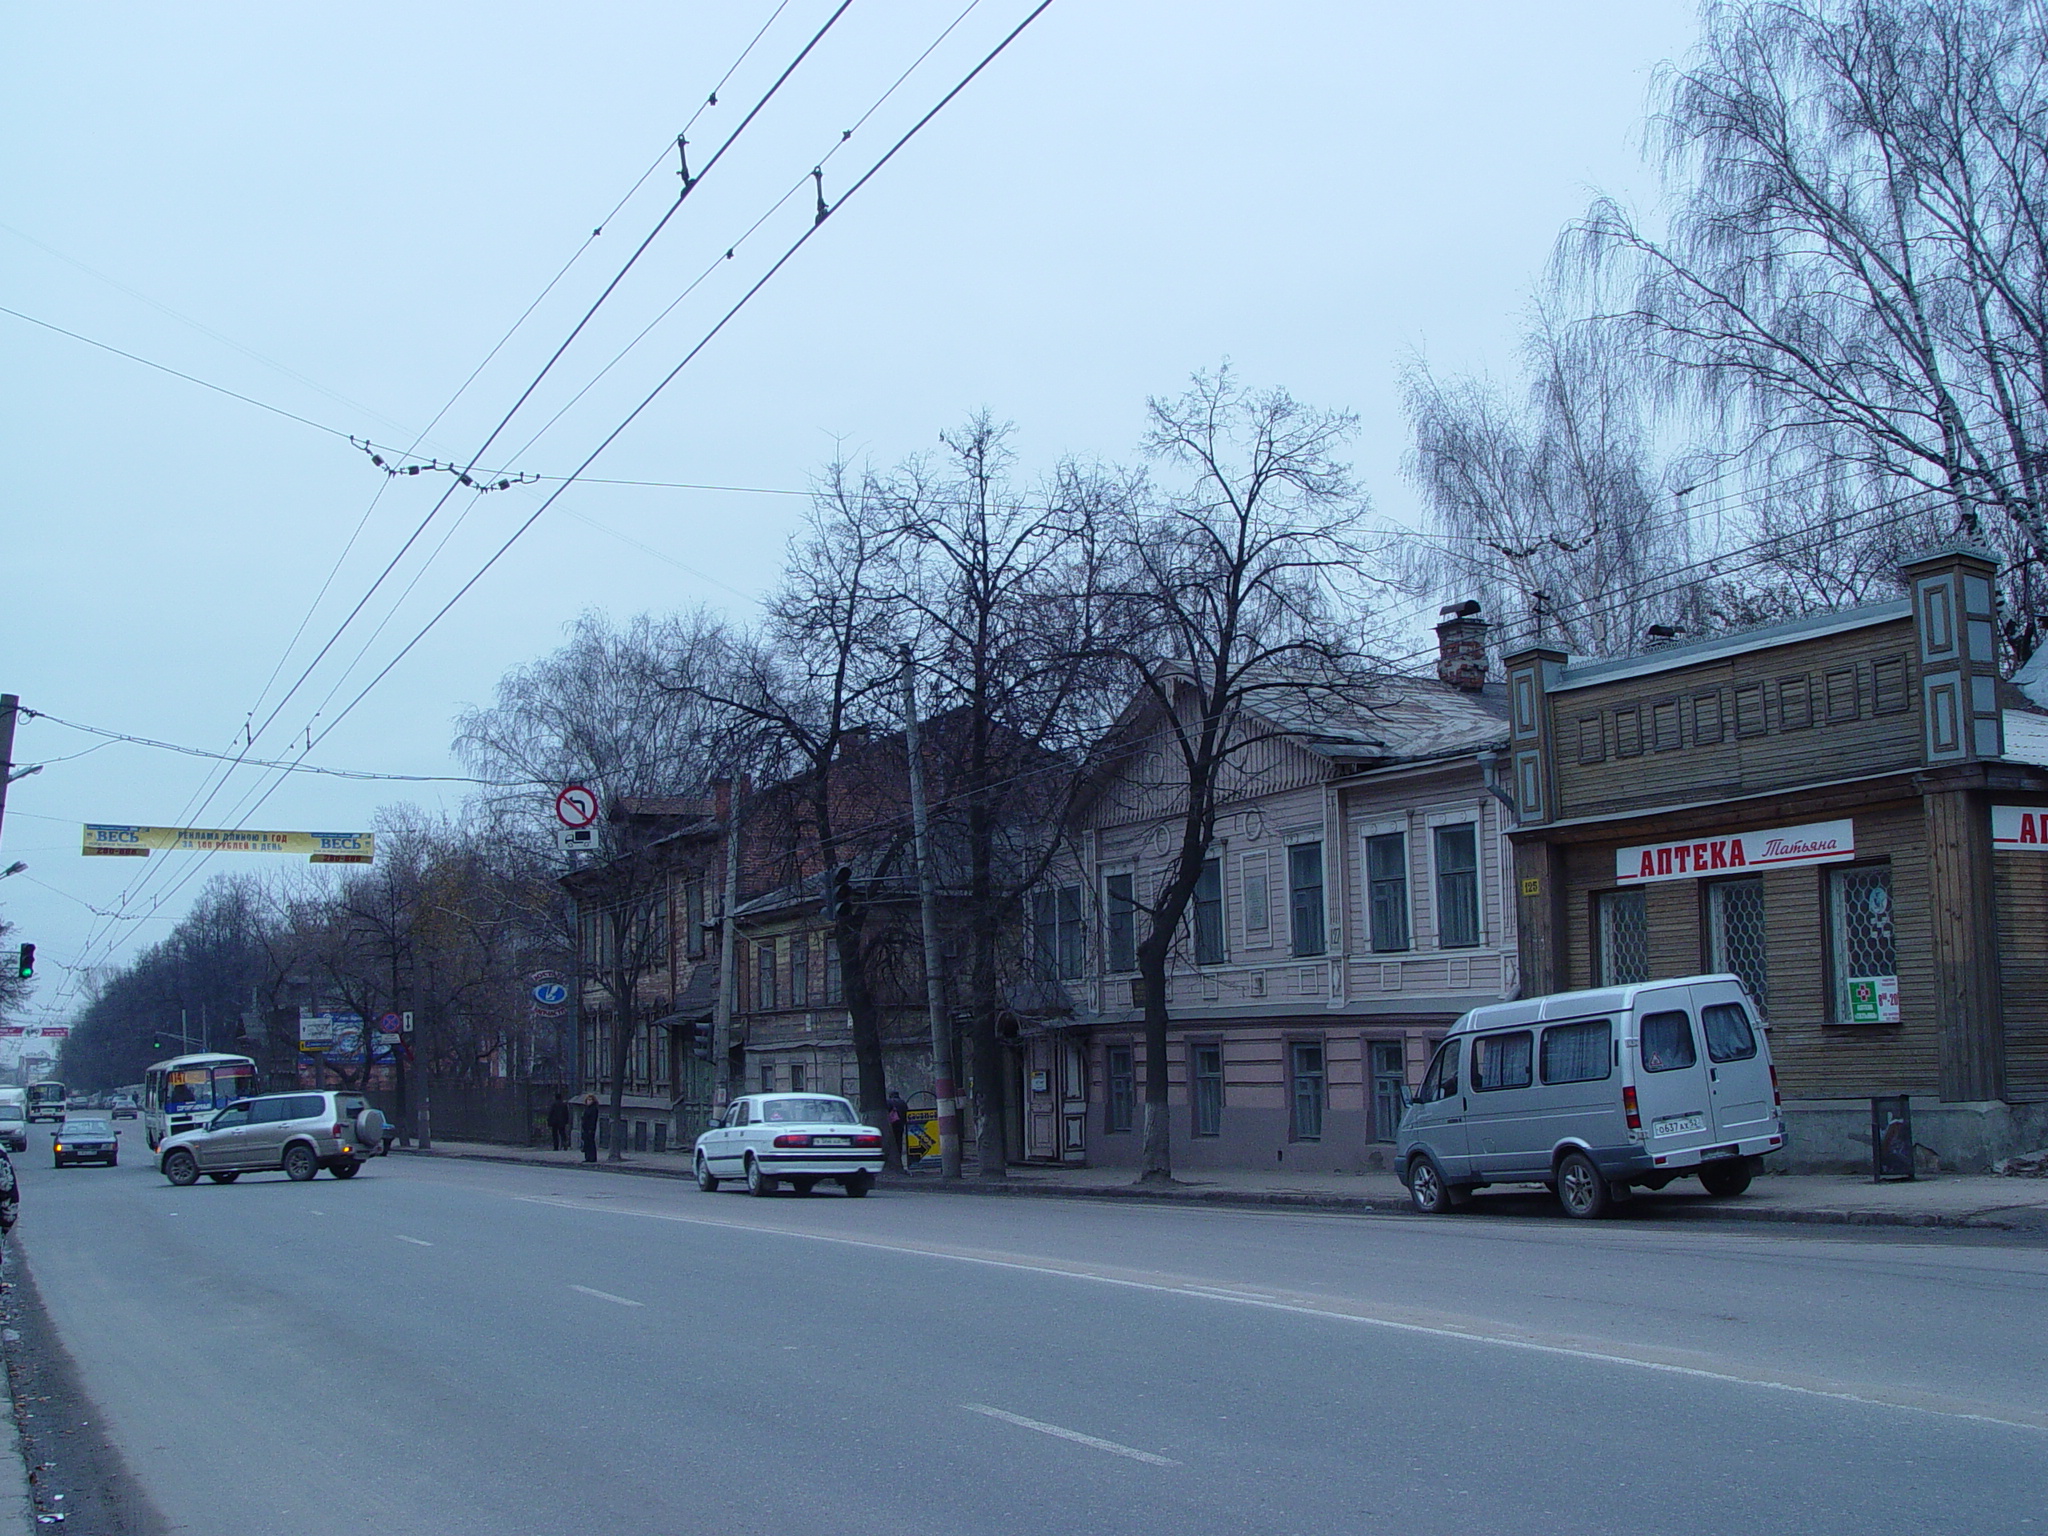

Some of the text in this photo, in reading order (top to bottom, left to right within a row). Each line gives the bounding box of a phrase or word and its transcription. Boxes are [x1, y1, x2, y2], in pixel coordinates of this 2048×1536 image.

[97, 831, 139, 843] ВЕСЬ
[262, 834, 268, 842] В
[271, 834, 288, 843] ГОД
[182, 840, 194, 848] ЗА
[215, 841, 249, 850] РУБЛЕЙ
[260, 843, 283, 851] ДЕНЬ
[320, 838, 362, 850] ВЕСЬ
[1640, 838, 1838, 877] АПТЕКА Татьяна
[1525, 880, 1538, 894] 125
